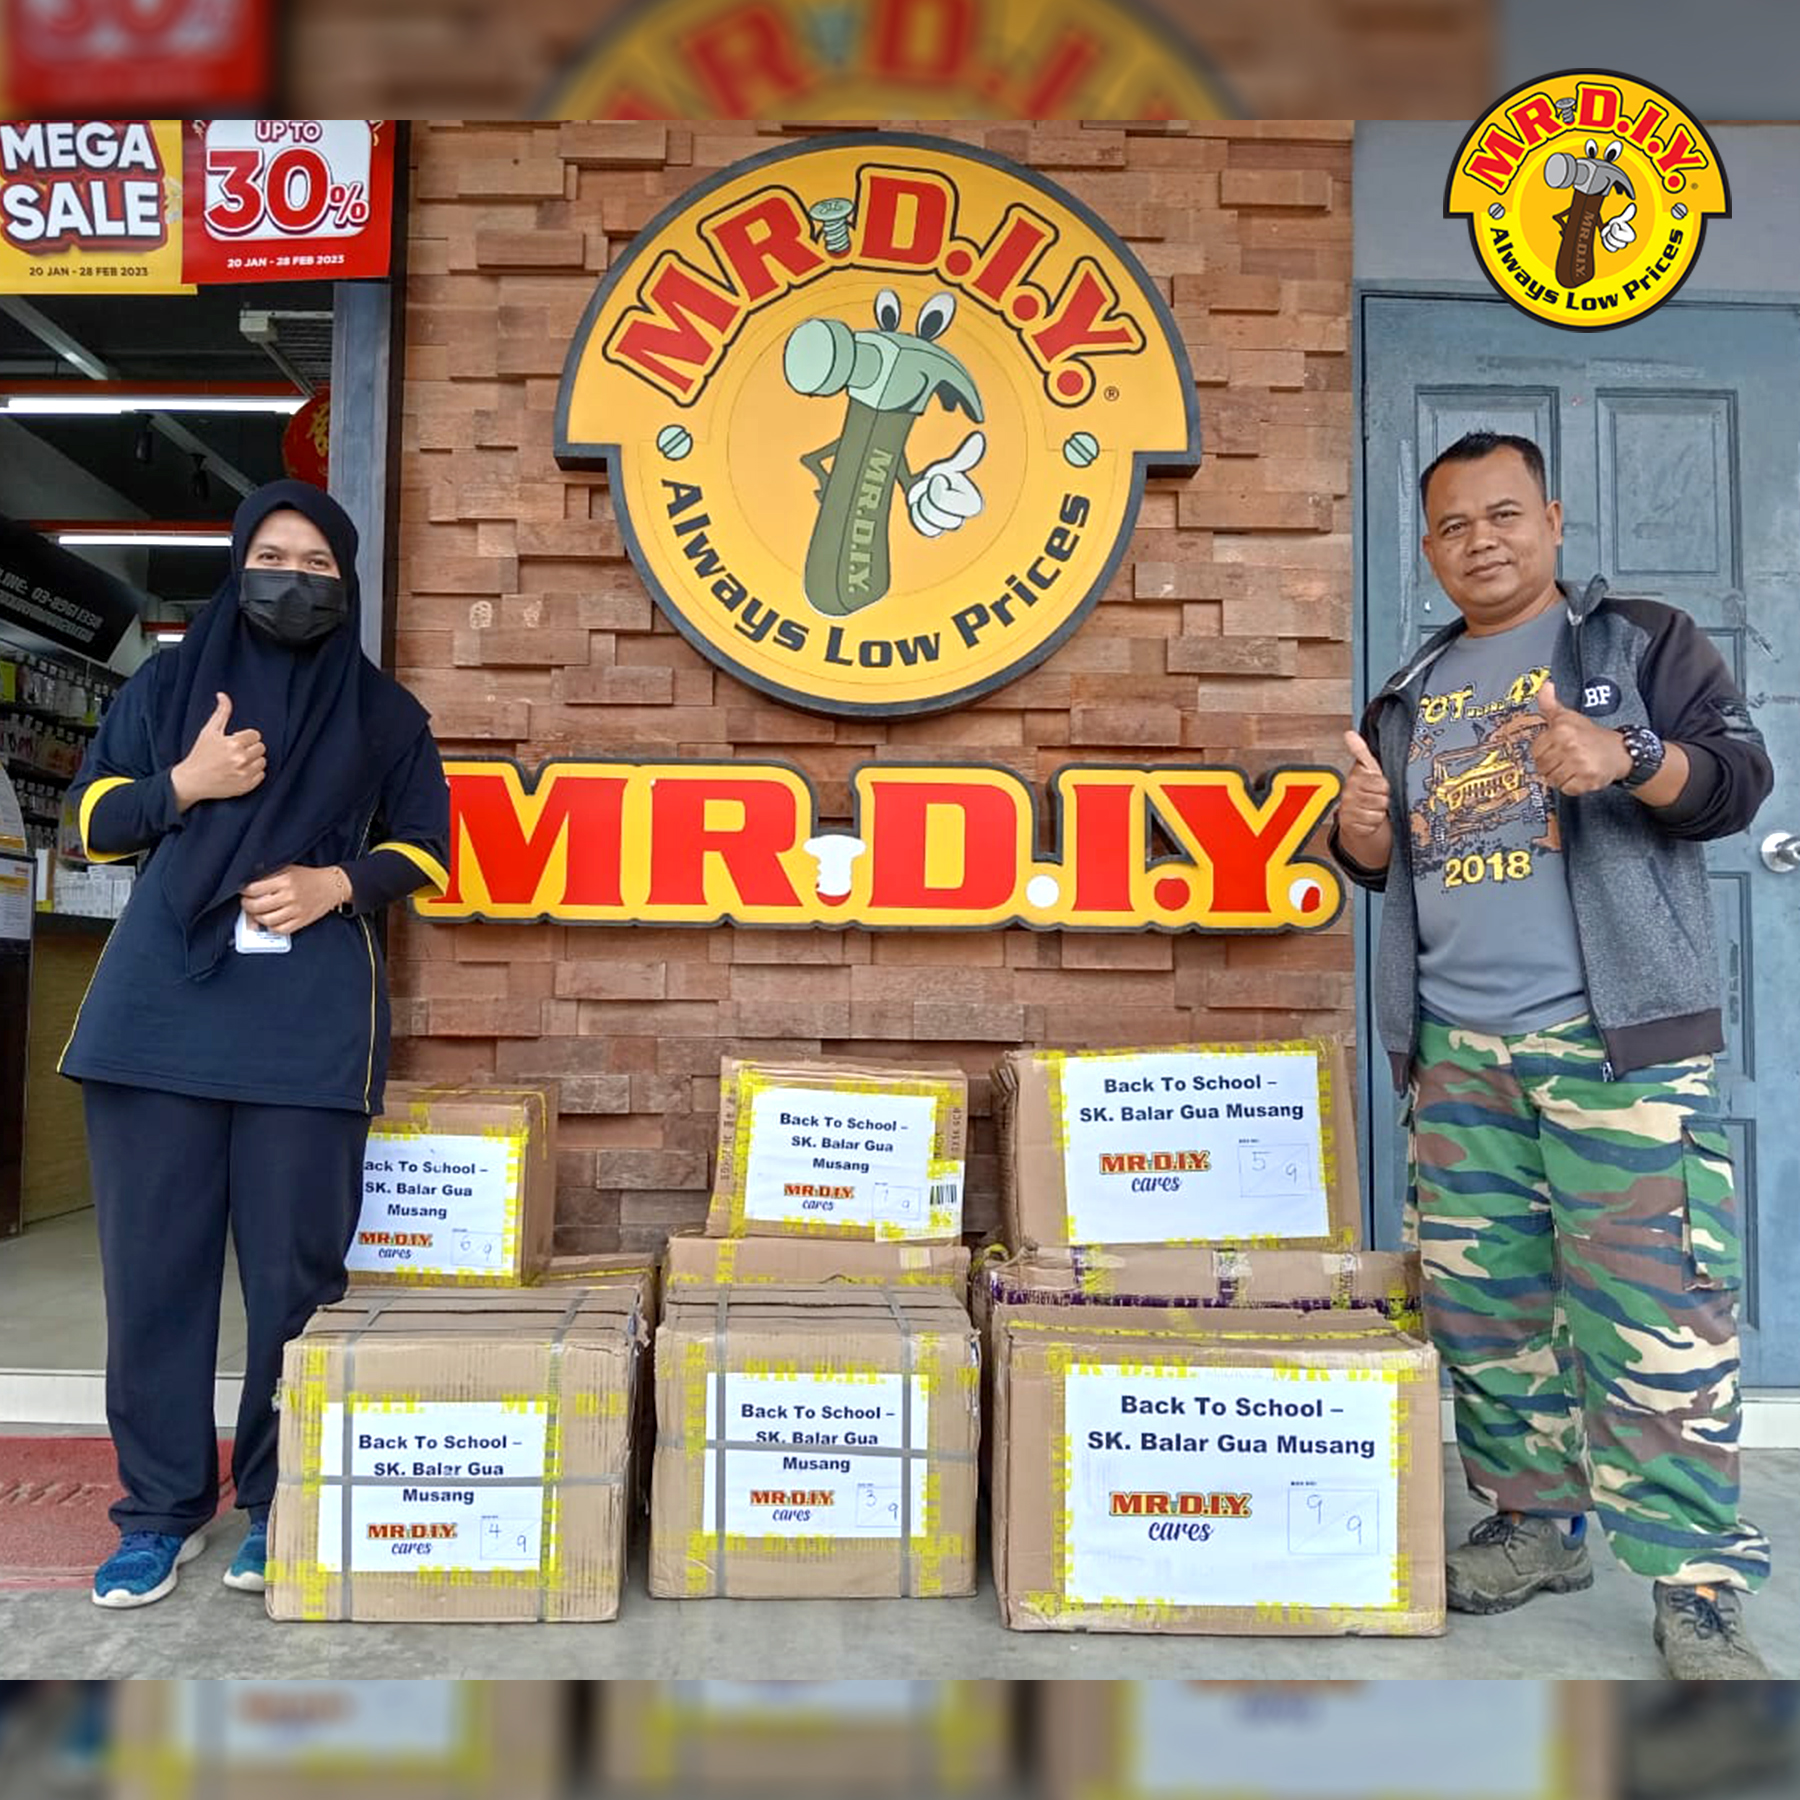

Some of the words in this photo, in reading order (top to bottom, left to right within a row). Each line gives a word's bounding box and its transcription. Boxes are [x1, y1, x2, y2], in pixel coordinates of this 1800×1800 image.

[256, 120, 287, 142] UP
[290, 121, 322, 143] TO
[0, 122, 157, 170] MEGA
[204, 146, 370, 236] 30%
[3, 181, 161, 240] SALE
[227, 258, 242, 268] 20
[244, 257, 267, 267] JAN
[276, 257, 291, 266] 28
[292, 256, 315, 266] FEB
[316, 255, 345, 265] 2023
[29, 267, 43, 276] 20
[47, 267, 69, 276] JAN
[79, 267, 93, 276] 28
[96, 267, 118, 276] FEB
[121, 267, 149, 276] 2023
[662, 478, 810, 652] Always
[825, 624, 941, 669] Low
[952, 490, 1092, 649] Prices
[1584, 685, 1611, 708] BF
[1445, 851, 1531, 888] 2018
[1104, 1077, 1154, 1093] Back
[1161, 1076, 1186, 1092] To
[1193, 1074, 1261, 1091] School
[1080, 1106, 1114, 1122] SK.
[1122, 1105, 1173, 1121] Balar
[1180, 1104, 1219, 1119] Gua
[1227, 1103, 1304, 1120] Musang
[780, 1112, 819, 1128] Back
[824, 1116, 842, 1128] To
[847, 1118, 897, 1132] School
[791, 1136, 816, 1148] SK.
[822, 1137, 860, 1150] Balar
[865, 1140, 893, 1152] Gua
[399, 1161, 418, 1173] To
[423, 1161, 476, 1175] School
[812, 1157, 869, 1173] Musang
[365, 1182, 391, 1194] SK.
[397, 1183, 436, 1195] Balar
[442, 1185, 473, 1197] Gua
[1131, 1176, 1181, 1192] cares
[388, 1204, 447, 1219] Musang
[802, 1199, 834, 1211] cares
[378, 1248, 411, 1259] cares
[741, 1403, 788, 1418] Back
[794, 1405, 816, 1419] To
[821, 1406, 881, 1420] School
[1121, 1395, 1185, 1414] Back
[1194, 1397, 1226, 1416] To
[1235, 1398, 1323, 1417] School
[359, 1434, 407, 1449] Back
[415, 1436, 437, 1449] To
[444, 1435, 507, 1449] School
[756, 1431, 786, 1444] SK.
[792, 1432, 838, 1445] Balar
[844, 1432, 878, 1445] Gua
[1088, 1431, 1130, 1451] SK.
[1141, 1432, 1209, 1452] Balar
[1217, 1433, 1267, 1453] Gua
[1277, 1435, 1375, 1459] Musang
[374, 1462, 405, 1476] SK.
[413, 1462, 461, 1476] Balar
[468, 1462, 504, 1476] Gua
[783, 1456, 851, 1473] Musang
[403, 1488, 474, 1505] Musang
[772, 1509, 811, 1522] cares
[1149, 1522, 1213, 1542] cares
[391, 1542, 432, 1555] cares
